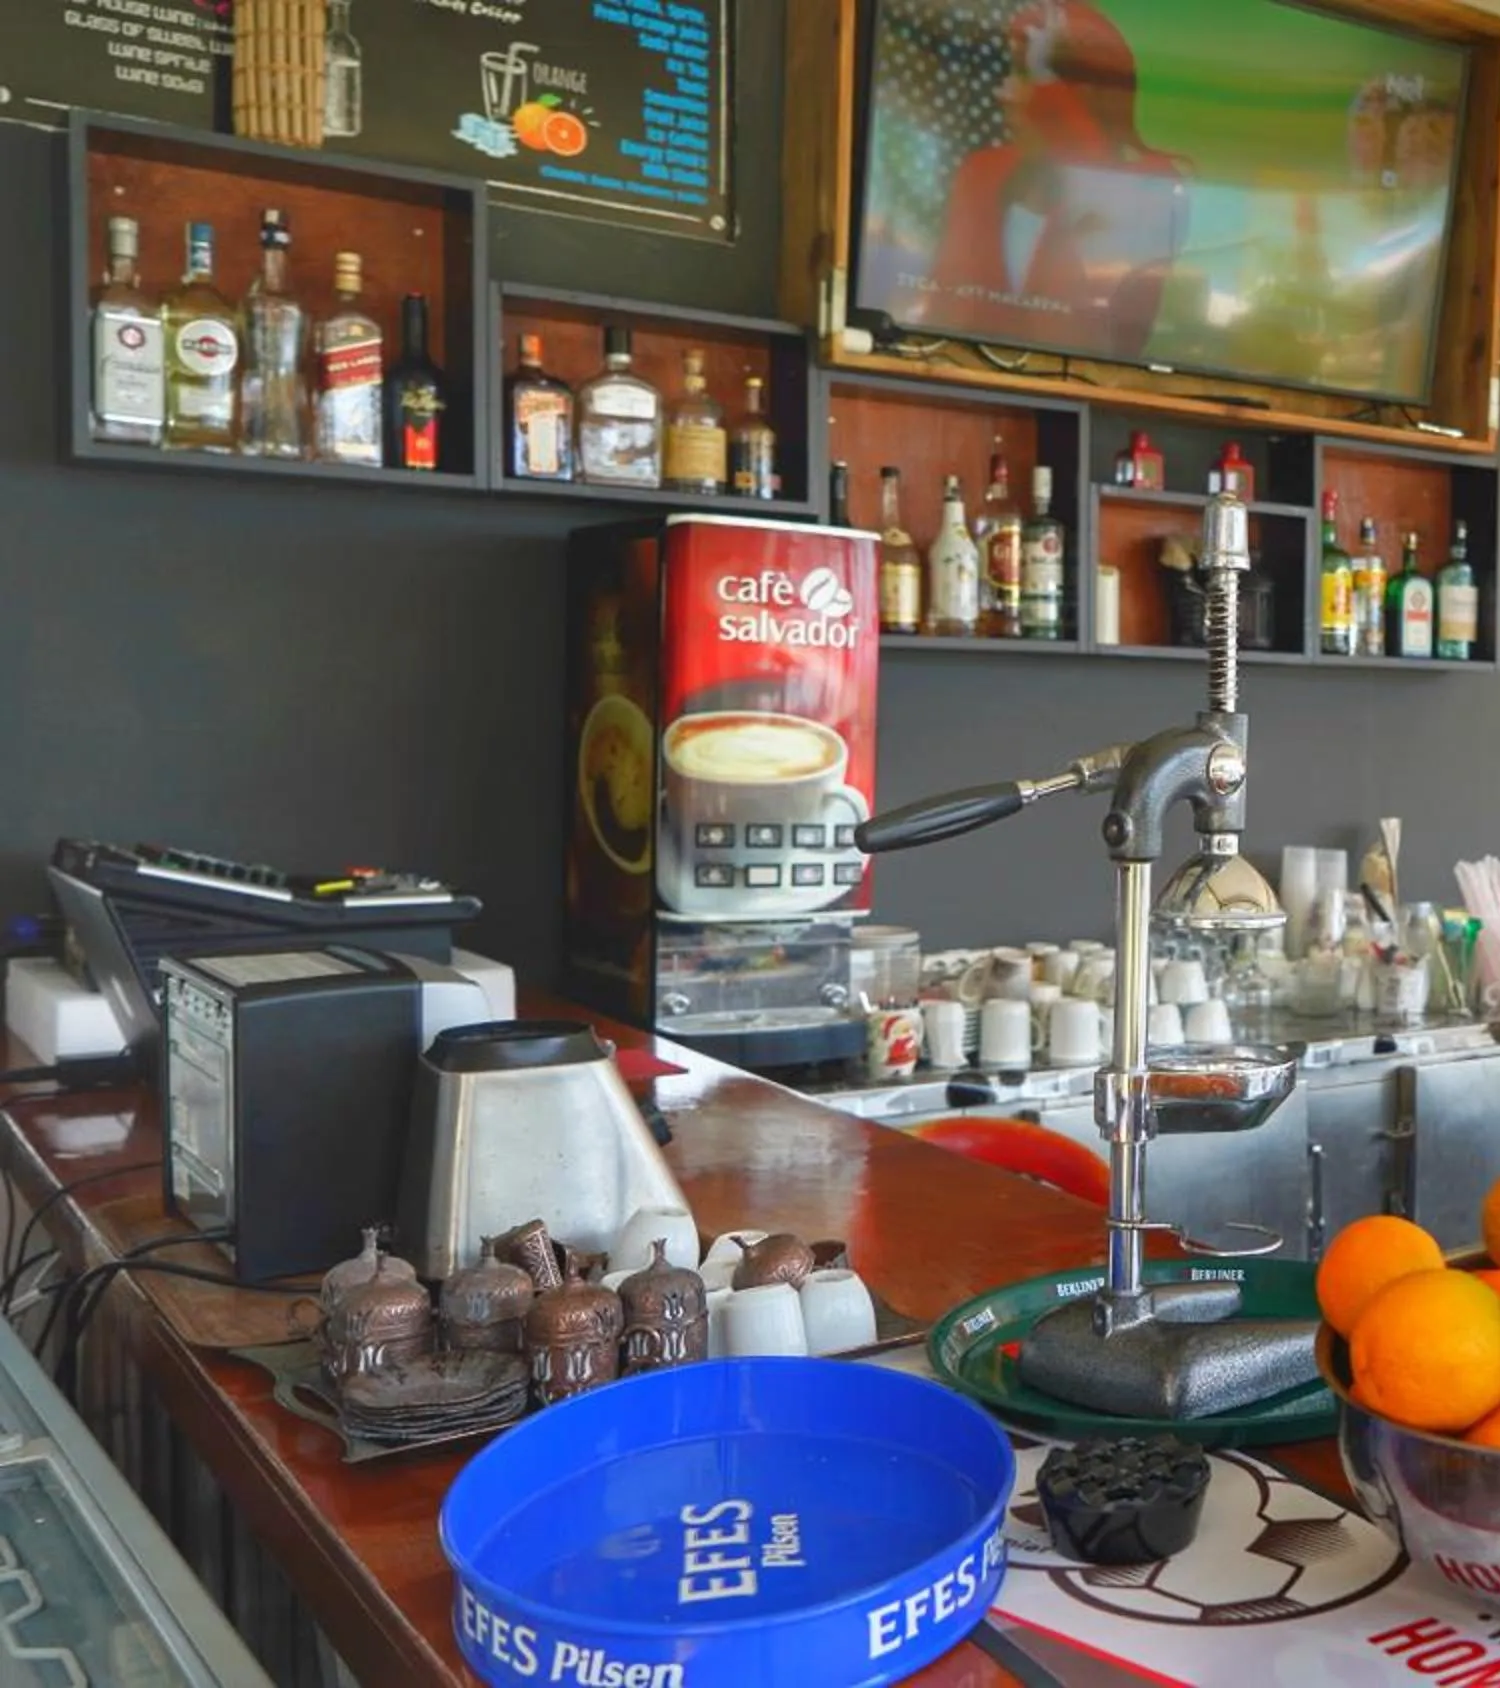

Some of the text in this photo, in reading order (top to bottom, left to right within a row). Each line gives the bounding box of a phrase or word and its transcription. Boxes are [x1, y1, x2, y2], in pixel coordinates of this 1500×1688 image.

[532, 62, 587, 94] ORANGE
[718, 609, 859, 648] salvador
[679, 1499, 757, 1605] EFES
[761, 1512, 807, 1567] Pilsen
[461, 1580, 685, 1688] EFES Pilsen
[867, 1553, 977, 1660] EFES
